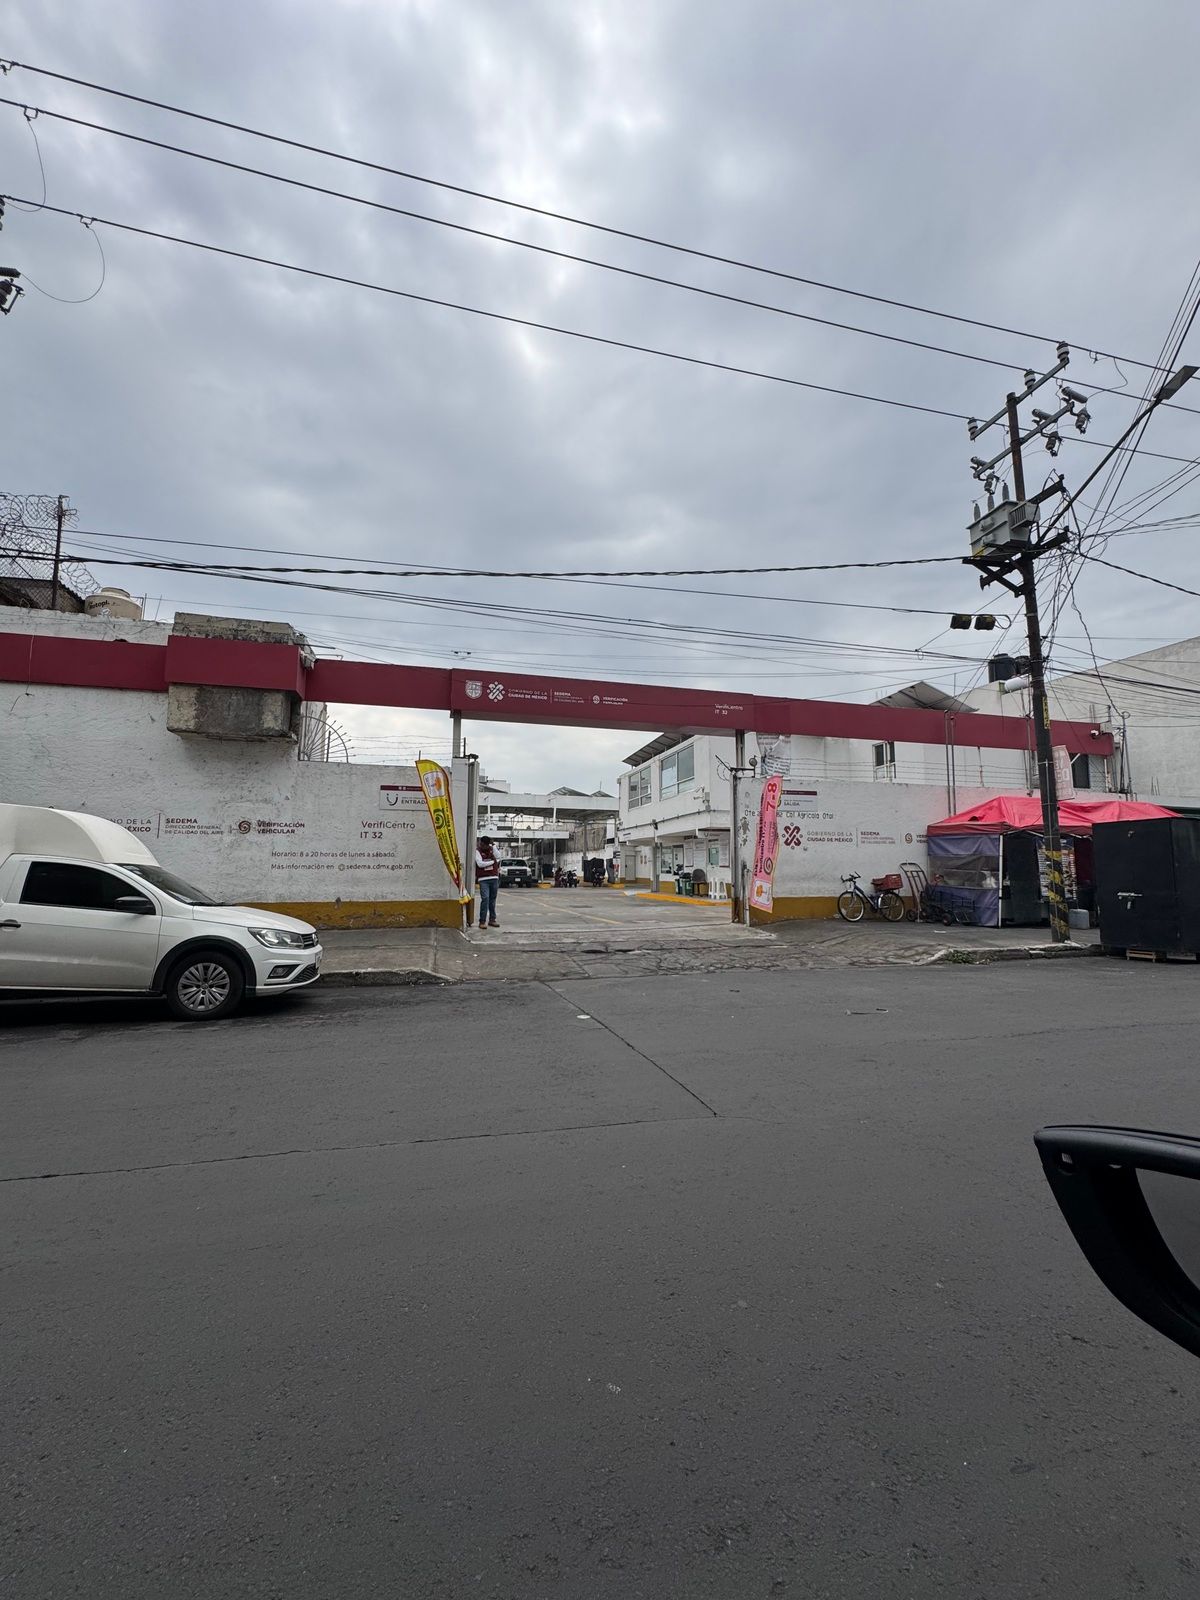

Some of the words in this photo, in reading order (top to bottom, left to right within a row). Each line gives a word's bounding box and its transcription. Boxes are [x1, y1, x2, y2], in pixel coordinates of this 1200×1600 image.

[361, 821, 416, 829] VerifiCentro
[360, 831, 369, 839] IT
[372, 831, 383, 839] 32
